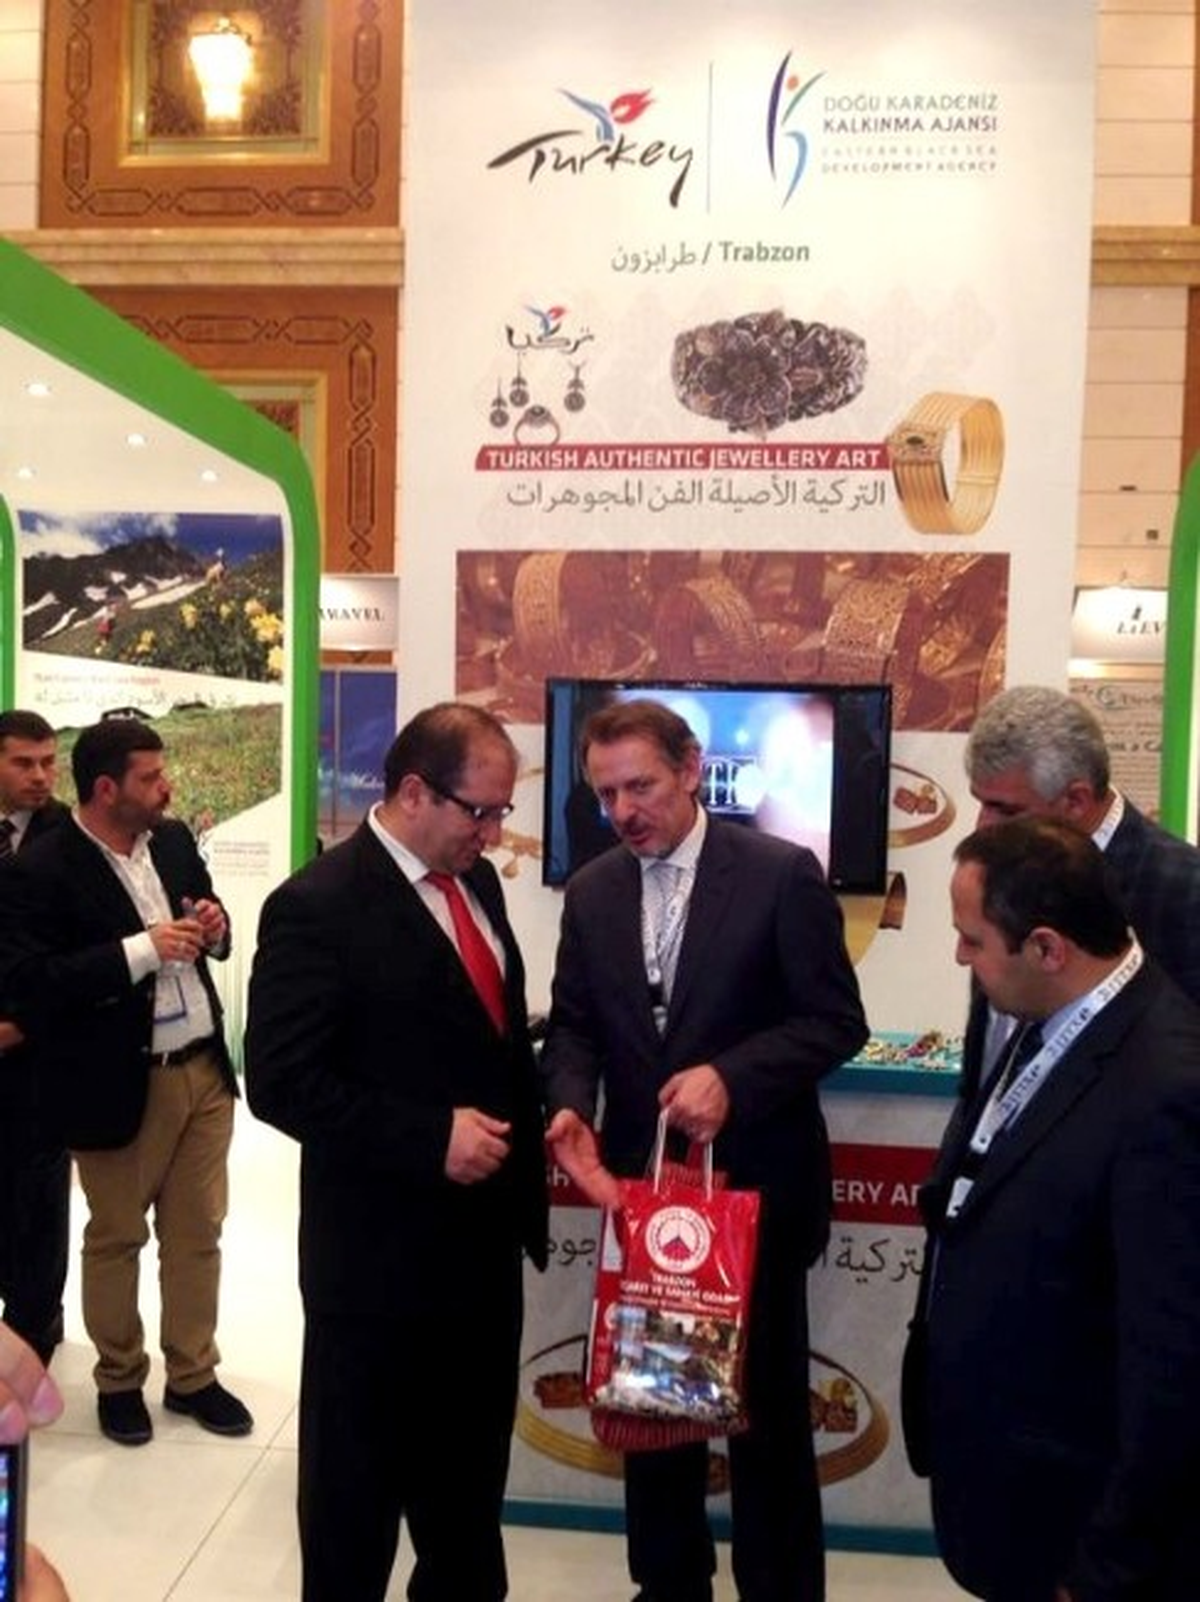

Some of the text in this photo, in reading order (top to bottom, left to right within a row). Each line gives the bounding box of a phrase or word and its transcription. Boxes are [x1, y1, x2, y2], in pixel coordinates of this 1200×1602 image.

[823, 115, 998, 134] KALKINMA AJANSI
[487, 129, 693, 208] Turkey
[611, 241, 697, 273] طرابزون
[718, 240, 810, 262] Trabzon
[488, 449, 881, 470] TURKISH AUTHENTIC JEWELLERY ART
[802, 478, 886, 513] التركية
